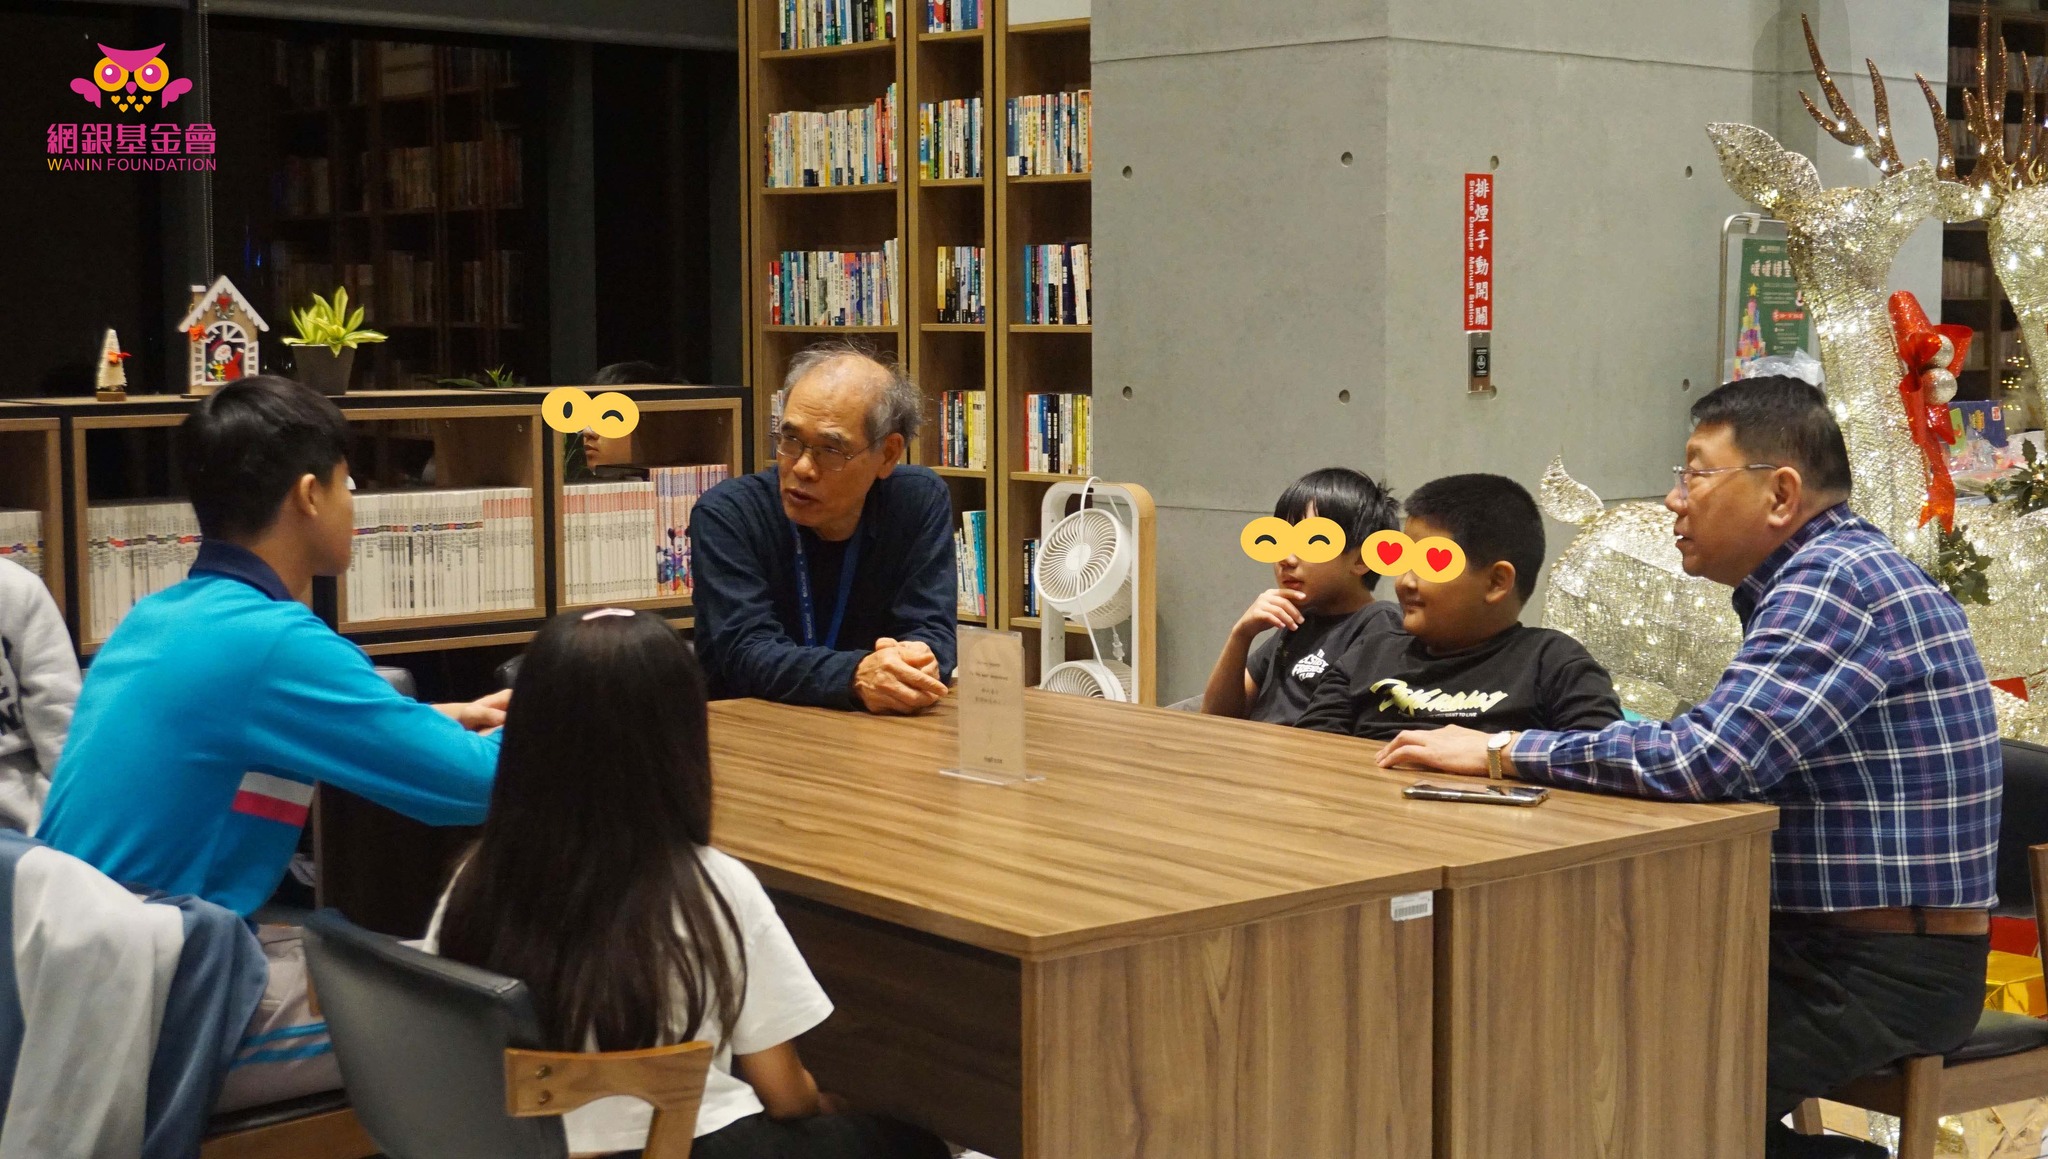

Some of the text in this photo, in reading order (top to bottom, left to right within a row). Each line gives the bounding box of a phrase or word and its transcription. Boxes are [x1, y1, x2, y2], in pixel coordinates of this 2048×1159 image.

[1474, 178, 1490, 326] 排煙手動開關
